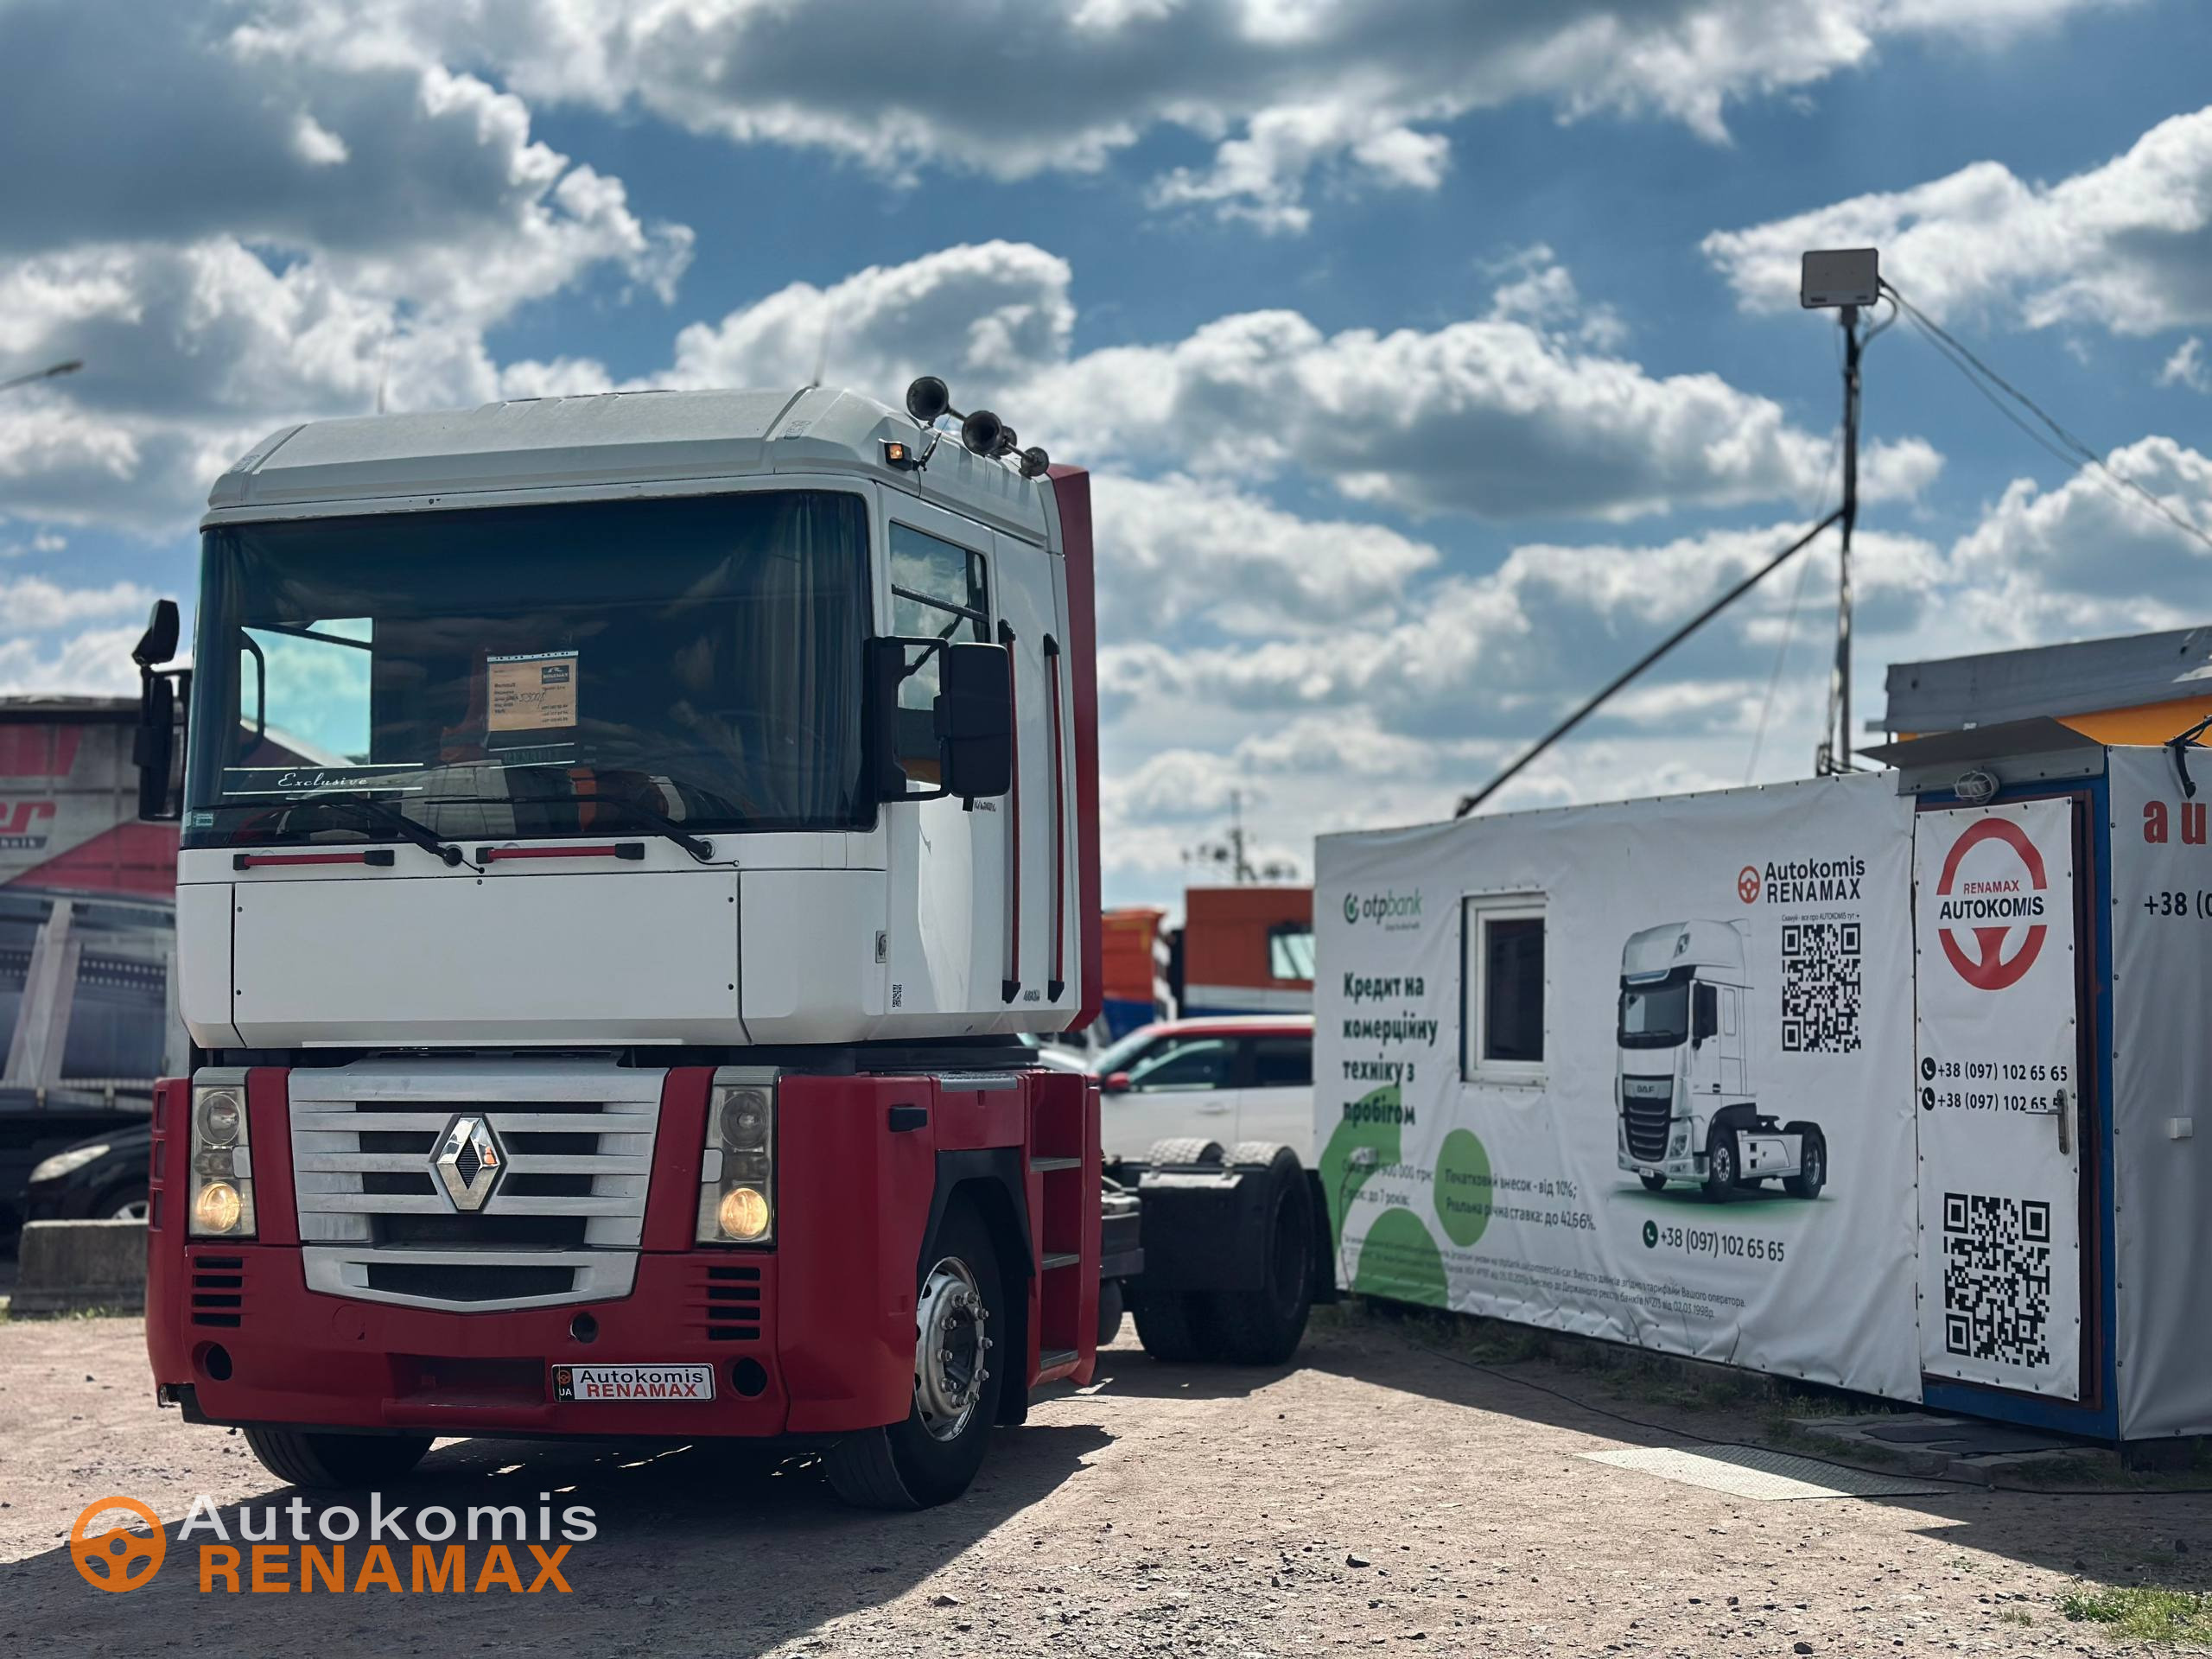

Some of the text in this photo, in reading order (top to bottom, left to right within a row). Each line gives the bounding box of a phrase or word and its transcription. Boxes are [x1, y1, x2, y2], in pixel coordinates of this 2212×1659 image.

[277, 772, 369, 787] Exclusive
[1764, 855, 1866, 881] Autokomis
[1767, 878, 1861, 904] RENAMAX
[1963, 880, 2020, 895] RENAMAX
[1939, 896, 2045, 920] AUTOKOMIS
[2144, 891, 2188, 917] +38
[1344, 972, 1425, 1004] Кредит на
[1343, 1010, 1438, 1047] комерційну
[1343, 1052, 1415, 1089] техніку з
[1938, 1062, 2068, 1081] +38 (097) 102 65 65
[1344, 1095, 1416, 1128] пробігом
[1937, 1093, 1961, 1108] +38
[1965, 1092, 1999, 1111] (097)
[2004, 1096, 2026, 1111] 102
[2031, 1096, 2047, 1110] 65
[1500, 1176, 1532, 1192] внесок
[1539, 1179, 1554, 1198] від
[1545, 1211, 1559, 1227] до
[1661, 1227, 1785, 1262] +38 (097) 102 65 65
[580, 1369, 703, 1383] Autokomis
[559, 1388, 572, 1396] UA
[587, 1383, 698, 1398] RENAMAX
